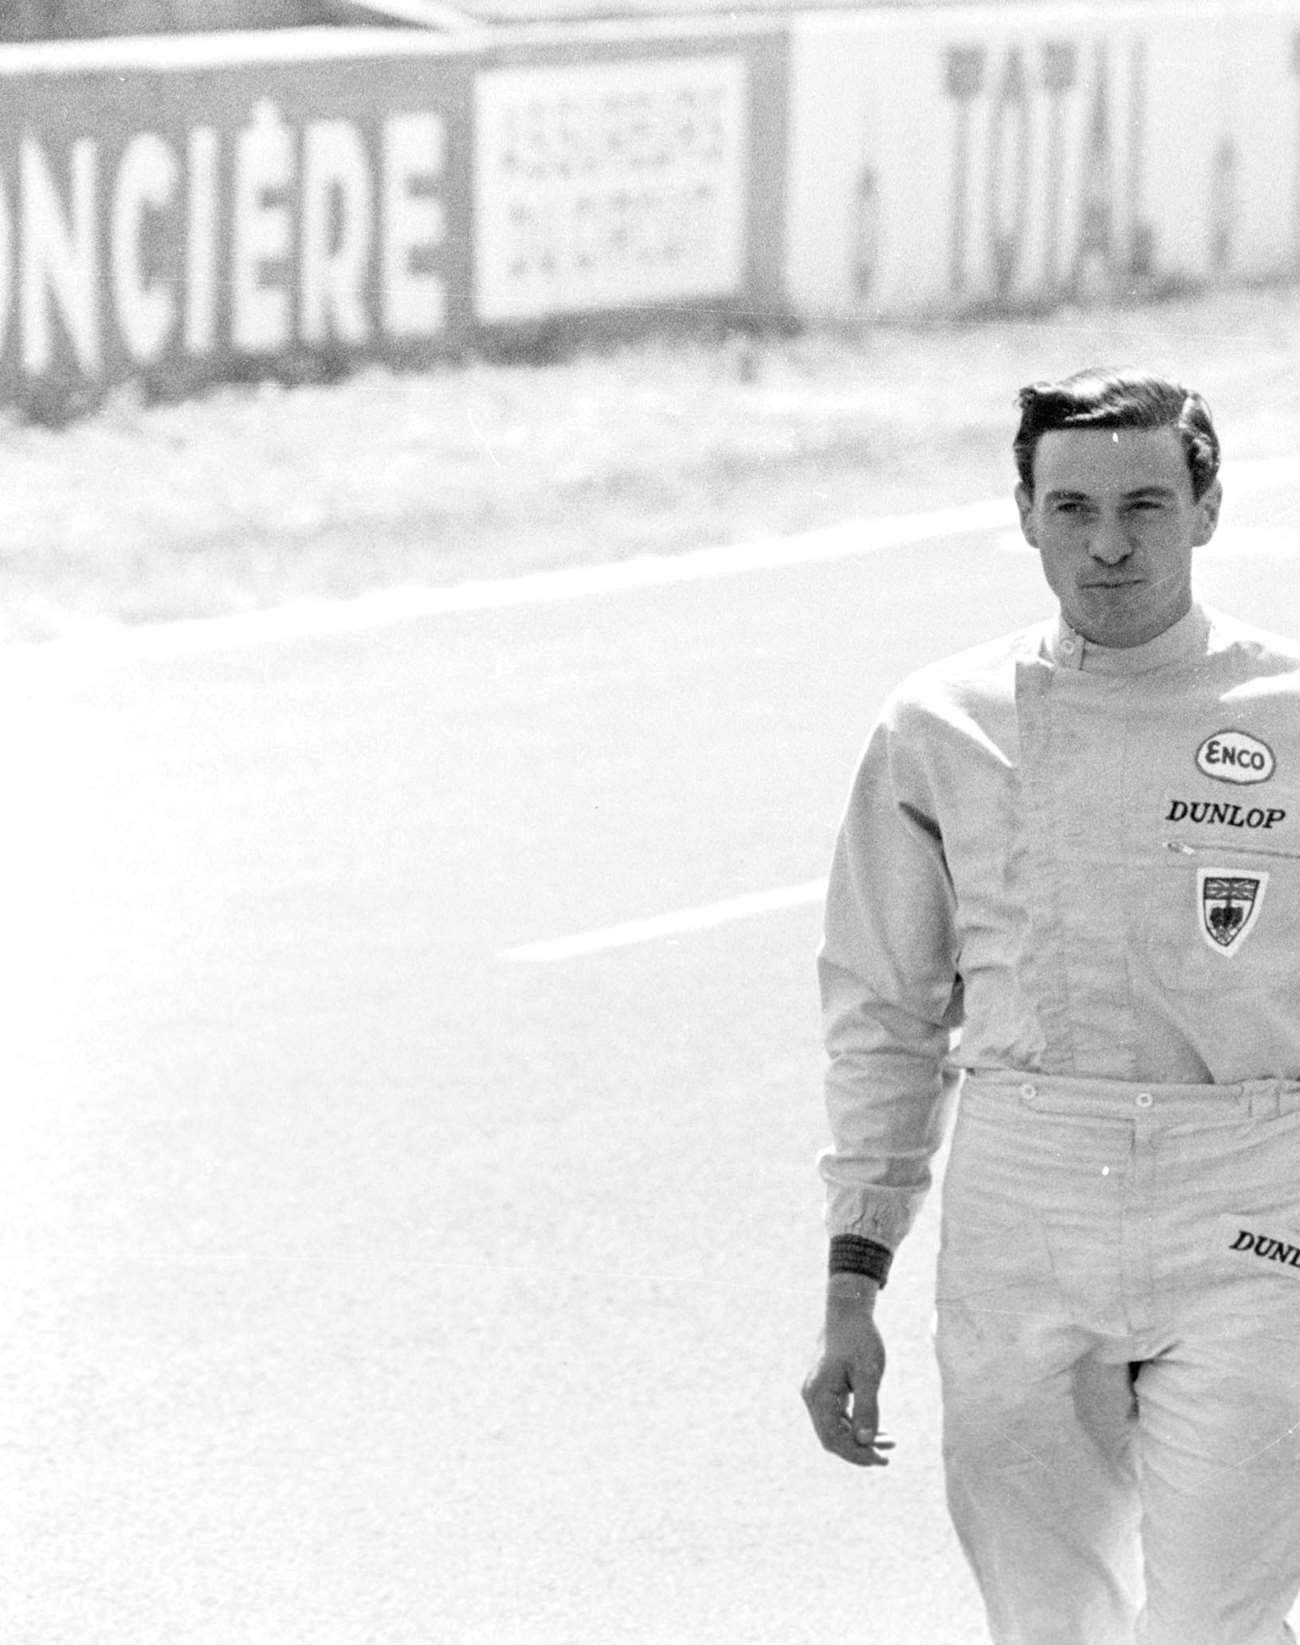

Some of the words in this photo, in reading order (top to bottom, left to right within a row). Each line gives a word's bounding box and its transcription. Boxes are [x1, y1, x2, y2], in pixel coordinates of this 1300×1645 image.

[0, 98, 447, 376] NCIÈRE
[1204, 740, 1265, 770] ENCO
[1165, 800, 1286, 830] DUNLOP
